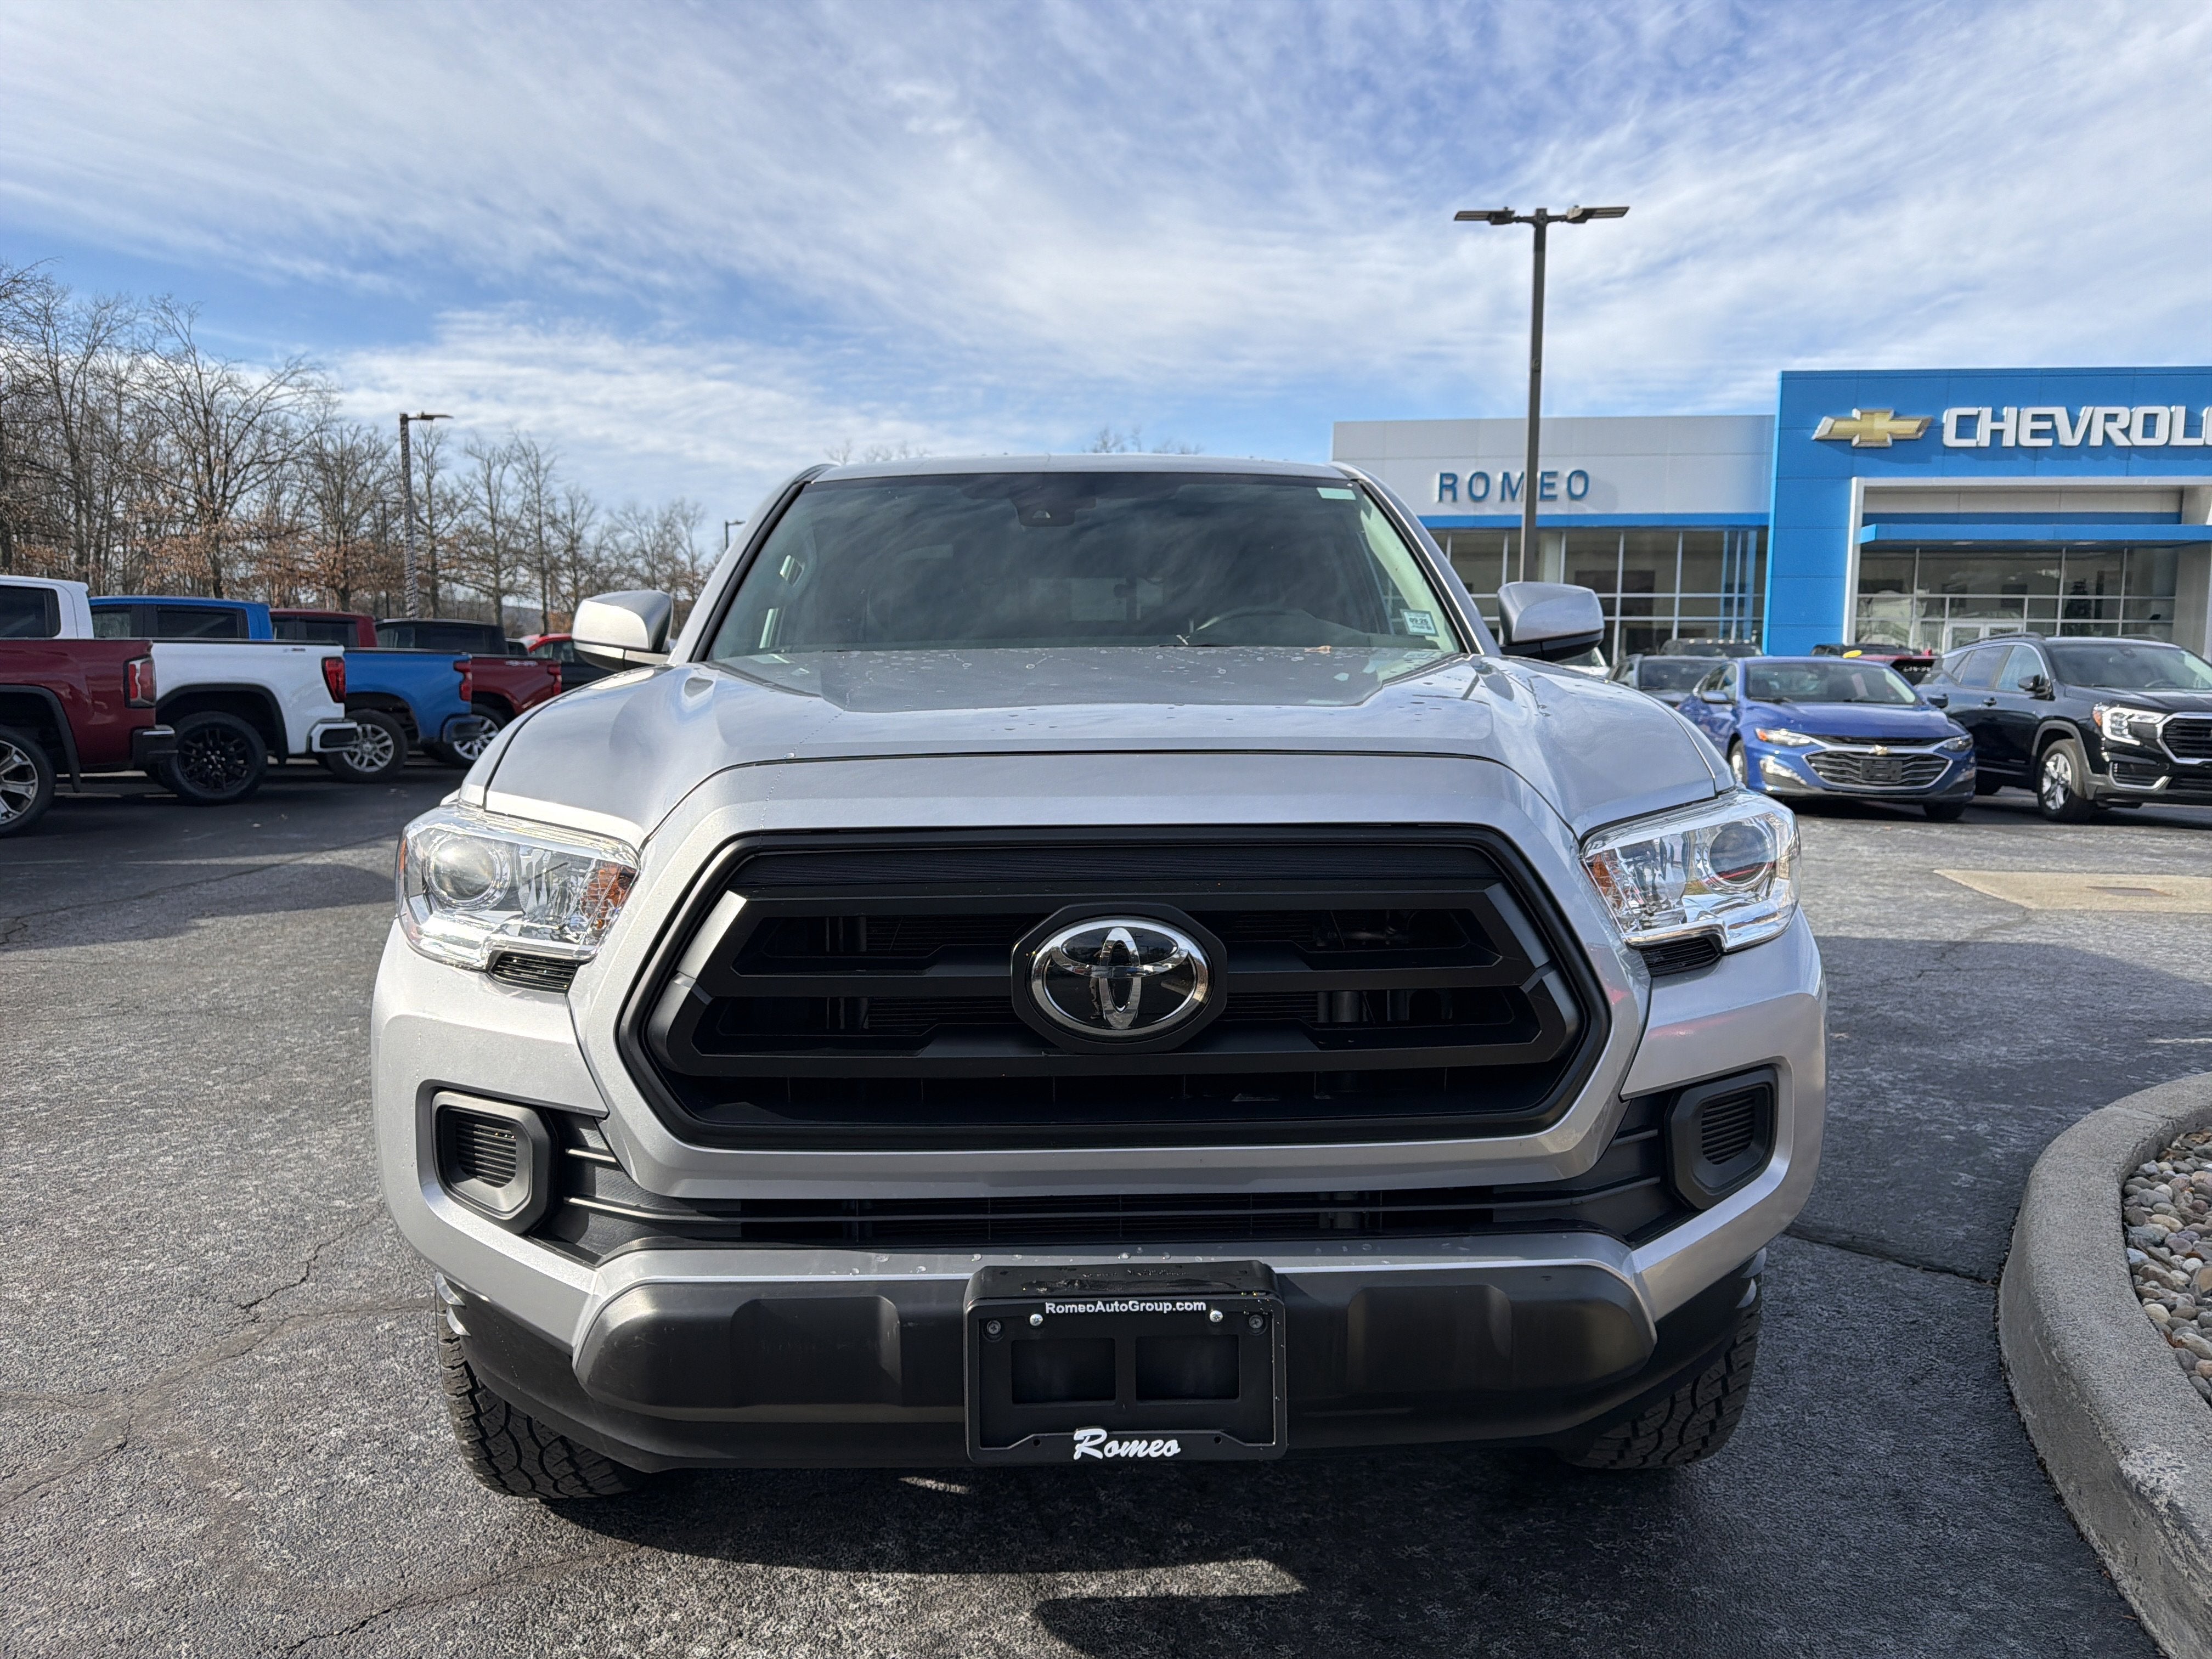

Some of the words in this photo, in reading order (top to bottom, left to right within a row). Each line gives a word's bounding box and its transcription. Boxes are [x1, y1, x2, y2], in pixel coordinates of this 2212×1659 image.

[1943, 405, 2212, 447] CHEVROL
[1436, 469, 1590, 503] ROMEO
[1045, 1300, 1206, 1314] RomeoAutoGroup.com
[1073, 1427, 1181, 1460] Romeo
